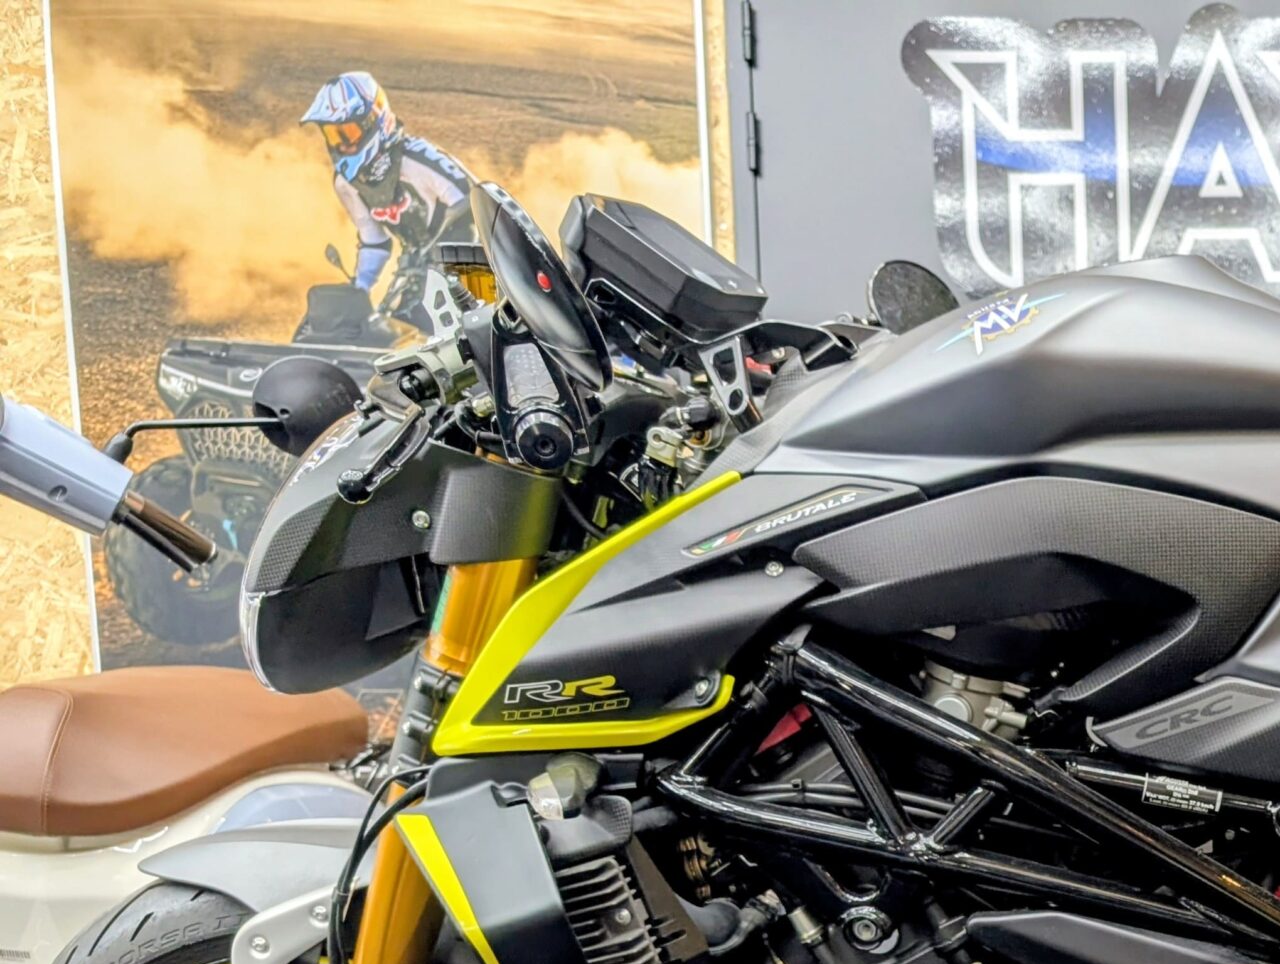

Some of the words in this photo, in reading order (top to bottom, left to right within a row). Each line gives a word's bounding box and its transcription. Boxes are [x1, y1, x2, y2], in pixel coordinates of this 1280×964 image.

[755, 492, 857, 533] BRUTALE
[503, 675, 626, 704] RR
[501, 697, 630, 721] 1000
[1135, 695, 1234, 740] CRC
